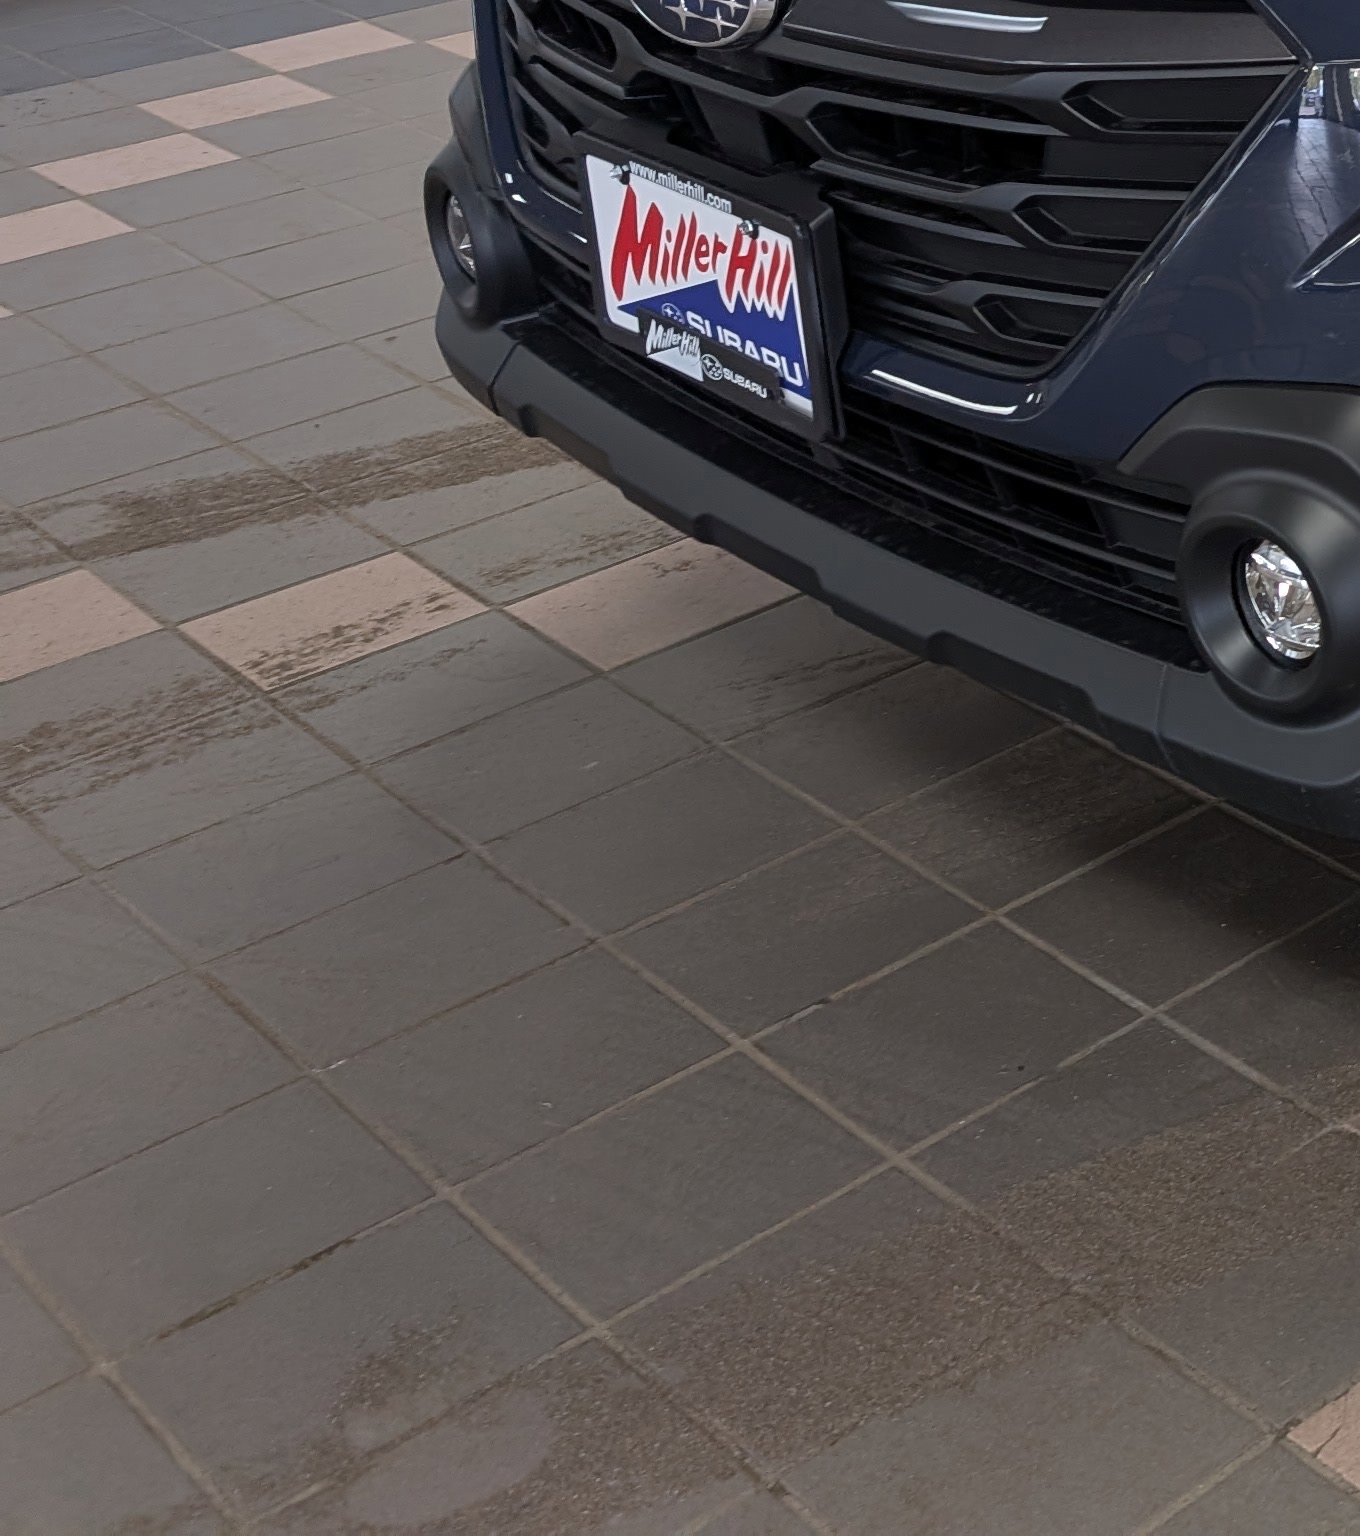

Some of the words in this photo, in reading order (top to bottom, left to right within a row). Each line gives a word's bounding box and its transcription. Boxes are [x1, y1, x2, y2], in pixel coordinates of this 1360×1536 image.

[629, 160, 732, 214] www.millerhill.com
[610, 184, 727, 302] Miller
[724, 224, 794, 310] Hill
[722, 367, 768, 399] SUBARU
